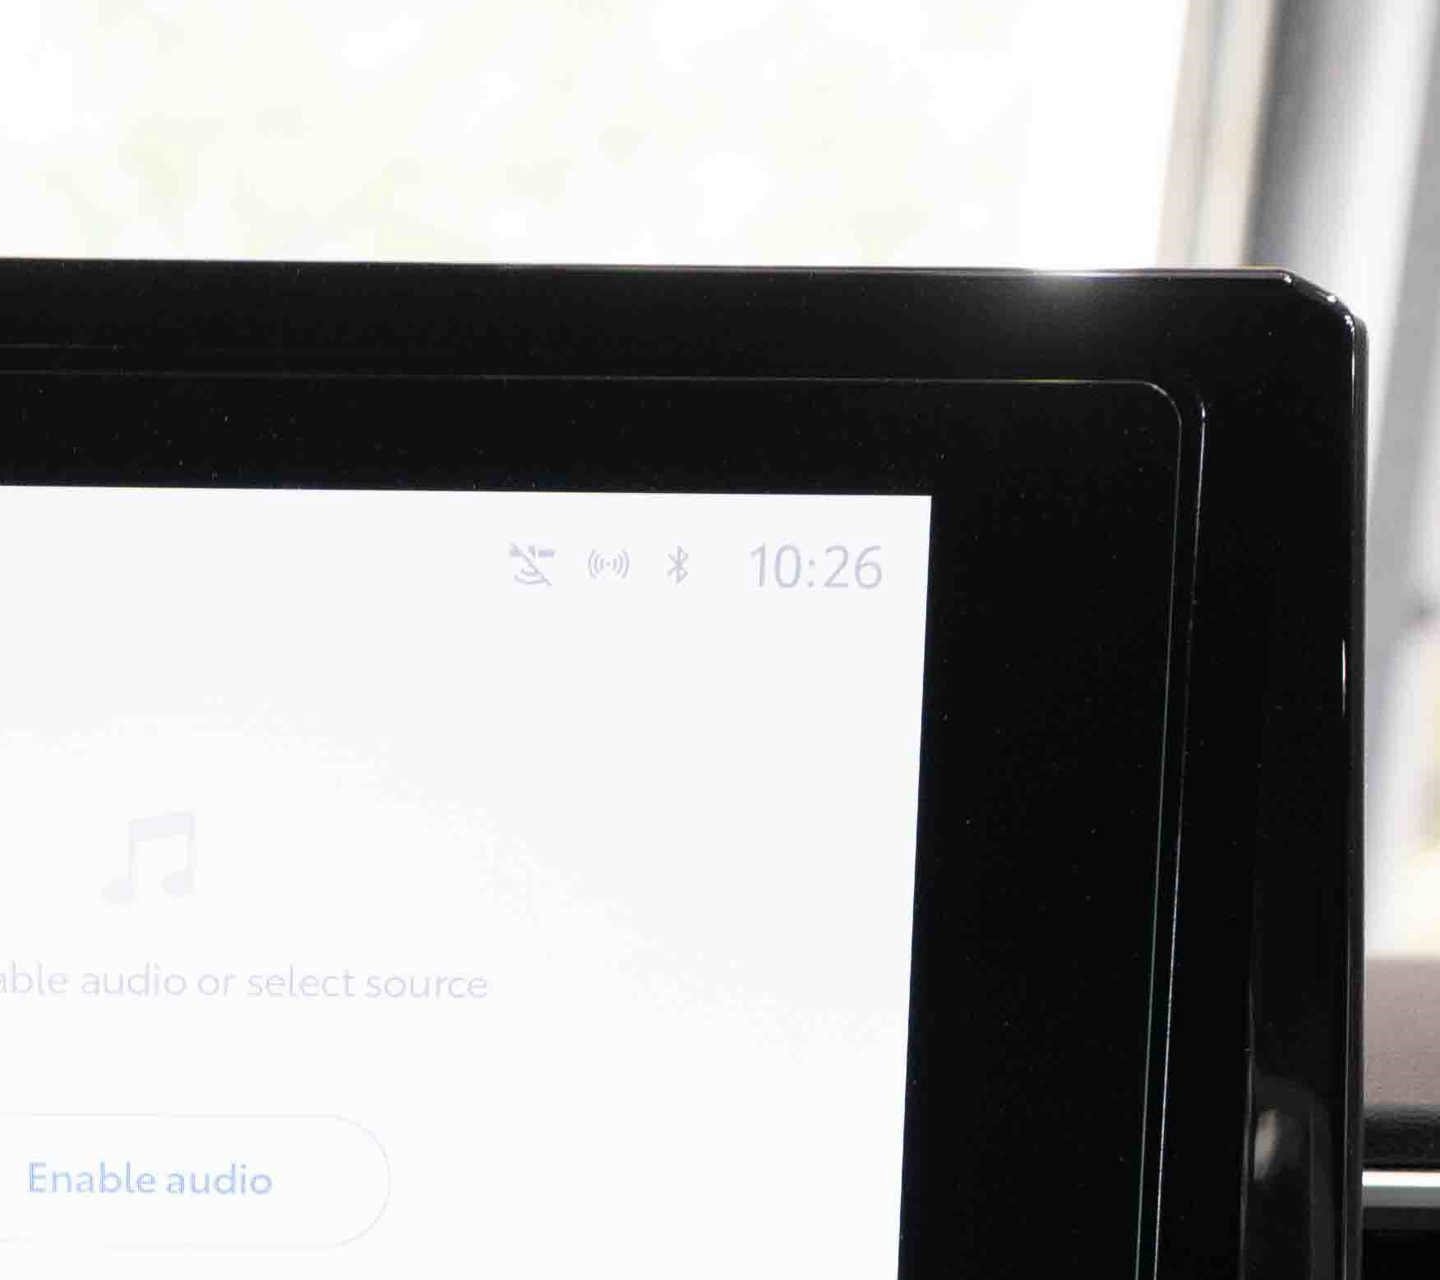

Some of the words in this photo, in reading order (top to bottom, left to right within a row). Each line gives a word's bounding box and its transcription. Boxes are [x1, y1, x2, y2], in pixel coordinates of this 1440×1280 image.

[749, 542, 883, 590] 10:26
[80, 962, 188, 998] audio
[196, 970, 237, 998] or
[247, 964, 356, 1000] select
[363, 968, 490, 1001] source
[25, 1159, 157, 1195] Enable
[165, 1160, 274, 1197] audio
